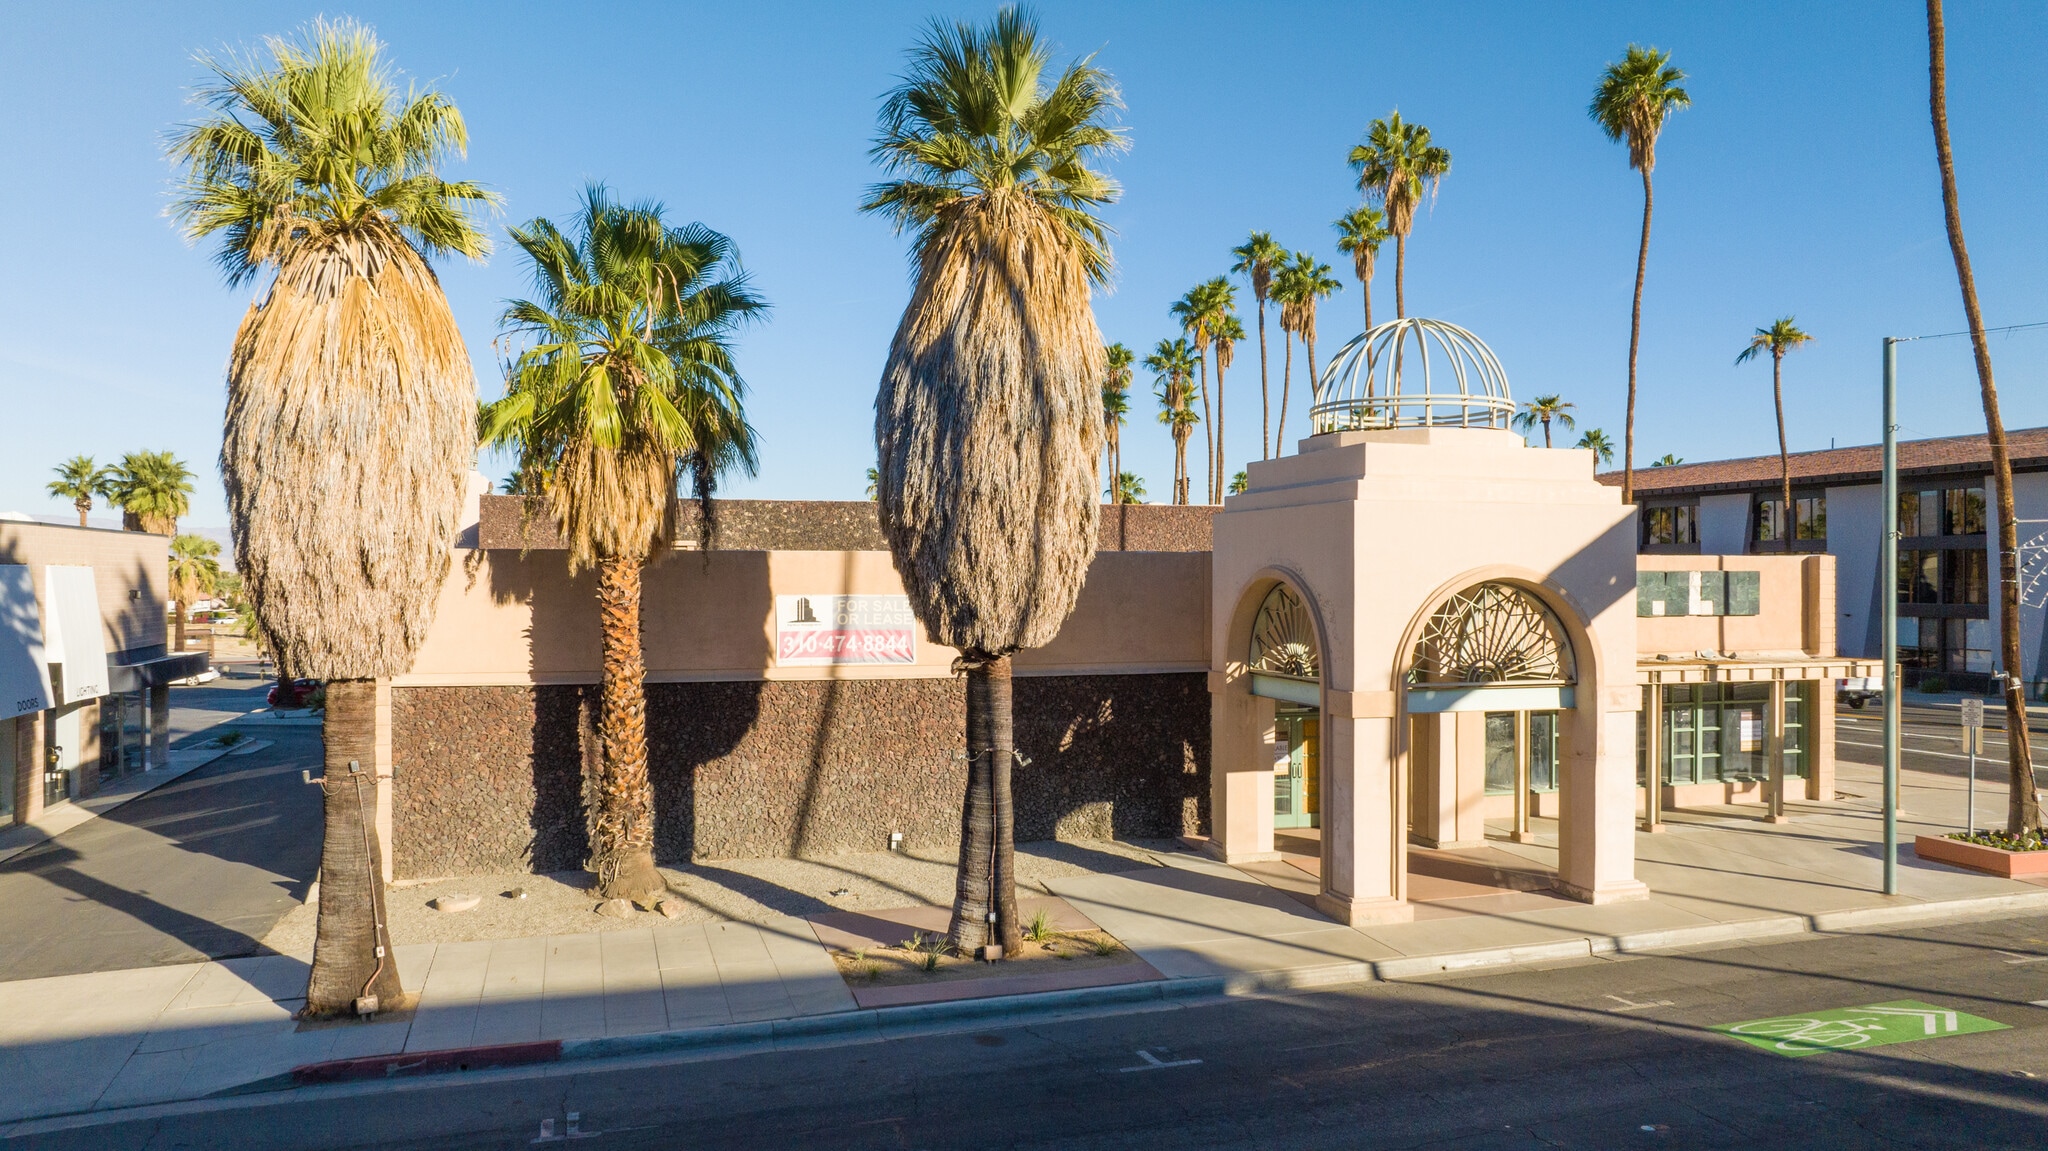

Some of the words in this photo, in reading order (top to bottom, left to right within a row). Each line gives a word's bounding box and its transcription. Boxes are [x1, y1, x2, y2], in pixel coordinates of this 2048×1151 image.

[837, 600, 868, 612] FOR
[873, 600, 911, 612] SALE
[837, 613, 859, 625] OR
[864, 613, 912, 625] LEASE
[76, 684, 99, 697] LIGHTING
[17, 697, 39, 712] DOORS
